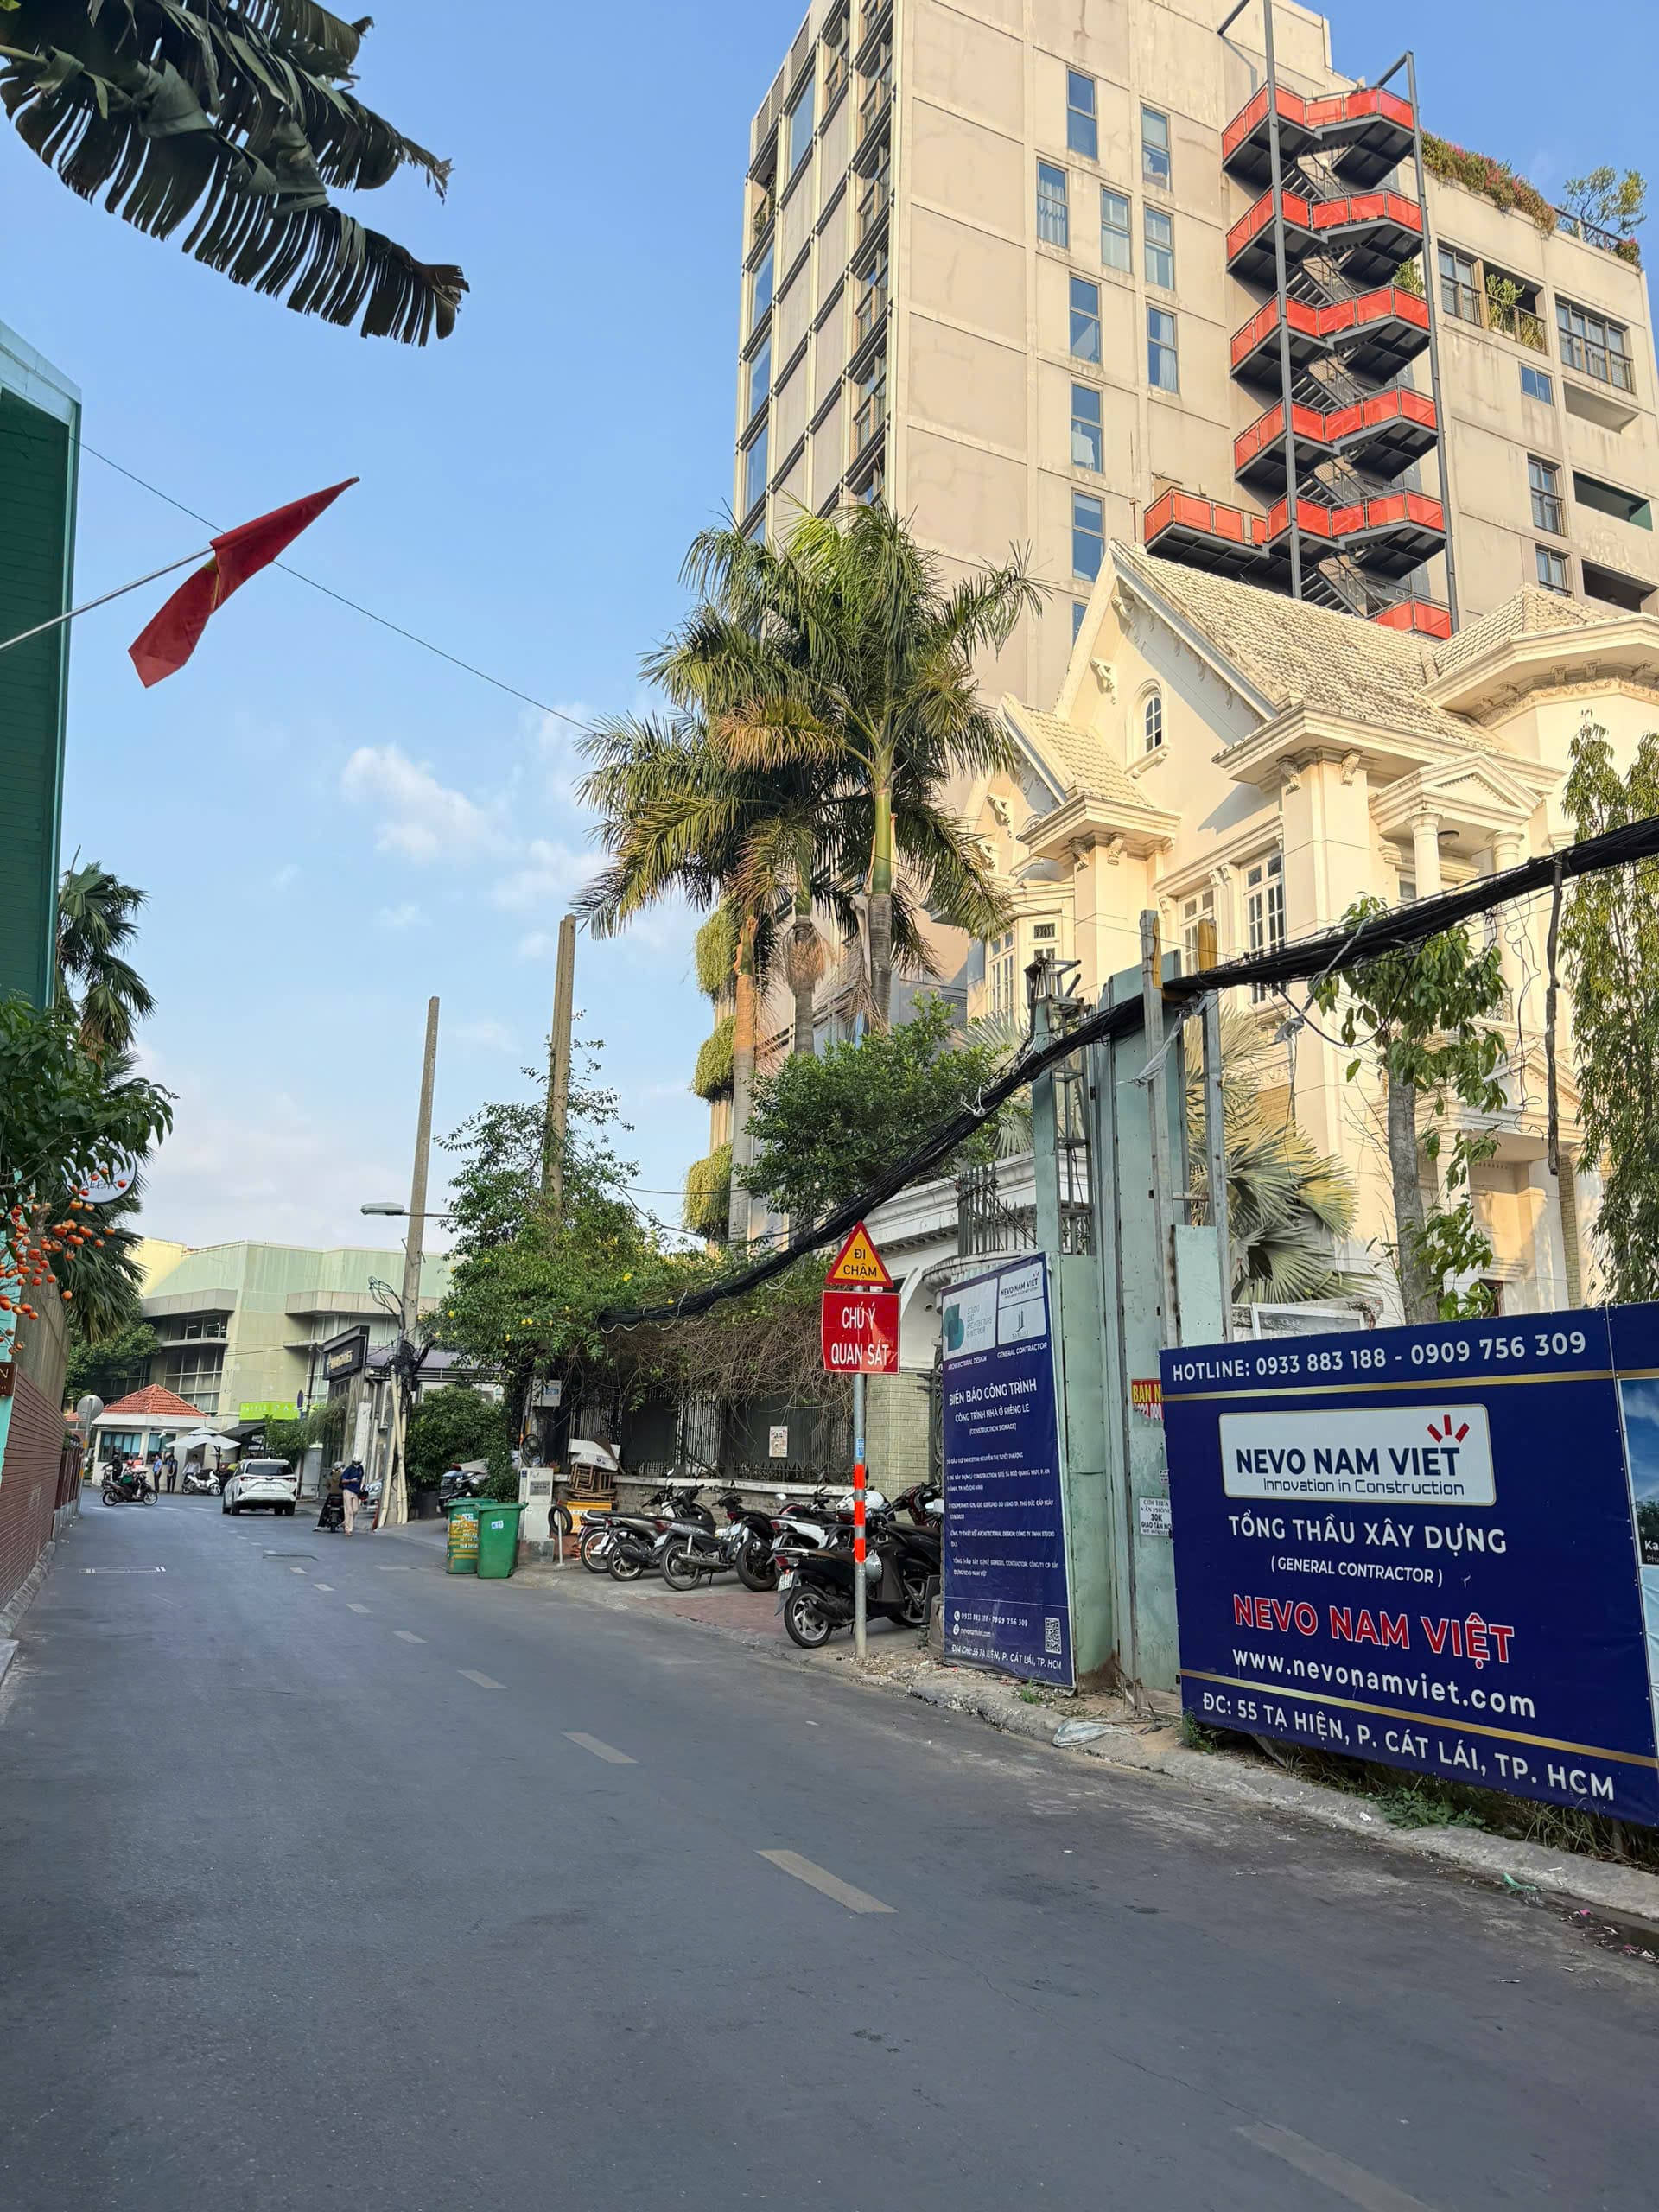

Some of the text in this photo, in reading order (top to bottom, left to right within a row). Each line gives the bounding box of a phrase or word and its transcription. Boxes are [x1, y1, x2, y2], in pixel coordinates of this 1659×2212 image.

[854, 1249, 866, 1260] ĐI
[842, 1301, 875, 1330] CHÚ Ý
[830, 1338, 890, 1366] QUAN SÁT
[1016, 1342, 1047, 1354] CONTRACTOR
[1173, 1360, 1249, 1381] HOTLINE:
[1256, 1355, 1300, 1375] 0933
[1307, 1351, 1343, 1371] 883
[1351, 1348, 1386, 1369] 188
[1411, 1341, 1469, 1364] 0909
[1479, 1337, 1525, 1359] 756
[1535, 1332, 1585, 1356] 309
[966, 1386, 982, 1402] BÁO
[984, 1382, 1008, 1399] CÔNG
[1008, 1377, 1038, 1395] TRÌNH
[955, 1412, 970, 1422] CÔNG
[970, 1409, 986, 1421] TRÌNH
[986, 1407, 999, 1418] NHÀ
[1004, 1403, 1022, 1415] RIÊNG
[1236, 1447, 1459, 1476] NEVO NAM VIET
[1264, 1478, 1464, 1495] Innovation in Construction
[1229, 1510, 1506, 1556] TỔNG THẦU XÂY DỰNG
[1278, 1557, 1335, 1574] GENERAL
[1338, 1562, 1433, 1583] CONTRACTOR
[1234, 1594, 1514, 1669] NEVO NAM VIỆT
[1002, 1652, 1008, 1661] P.
[1010, 1651, 1023, 1663] CÁT
[1037, 1657, 1046, 1668] TP.
[1047, 1660, 1062, 1669] HCM
[1233, 1649, 1535, 1718] www.nevonamviet.com
[1203, 1693, 1613, 1802] ĐC: 55 TẠ HIỆN, P. CÁT LÁI, TP. HCM
